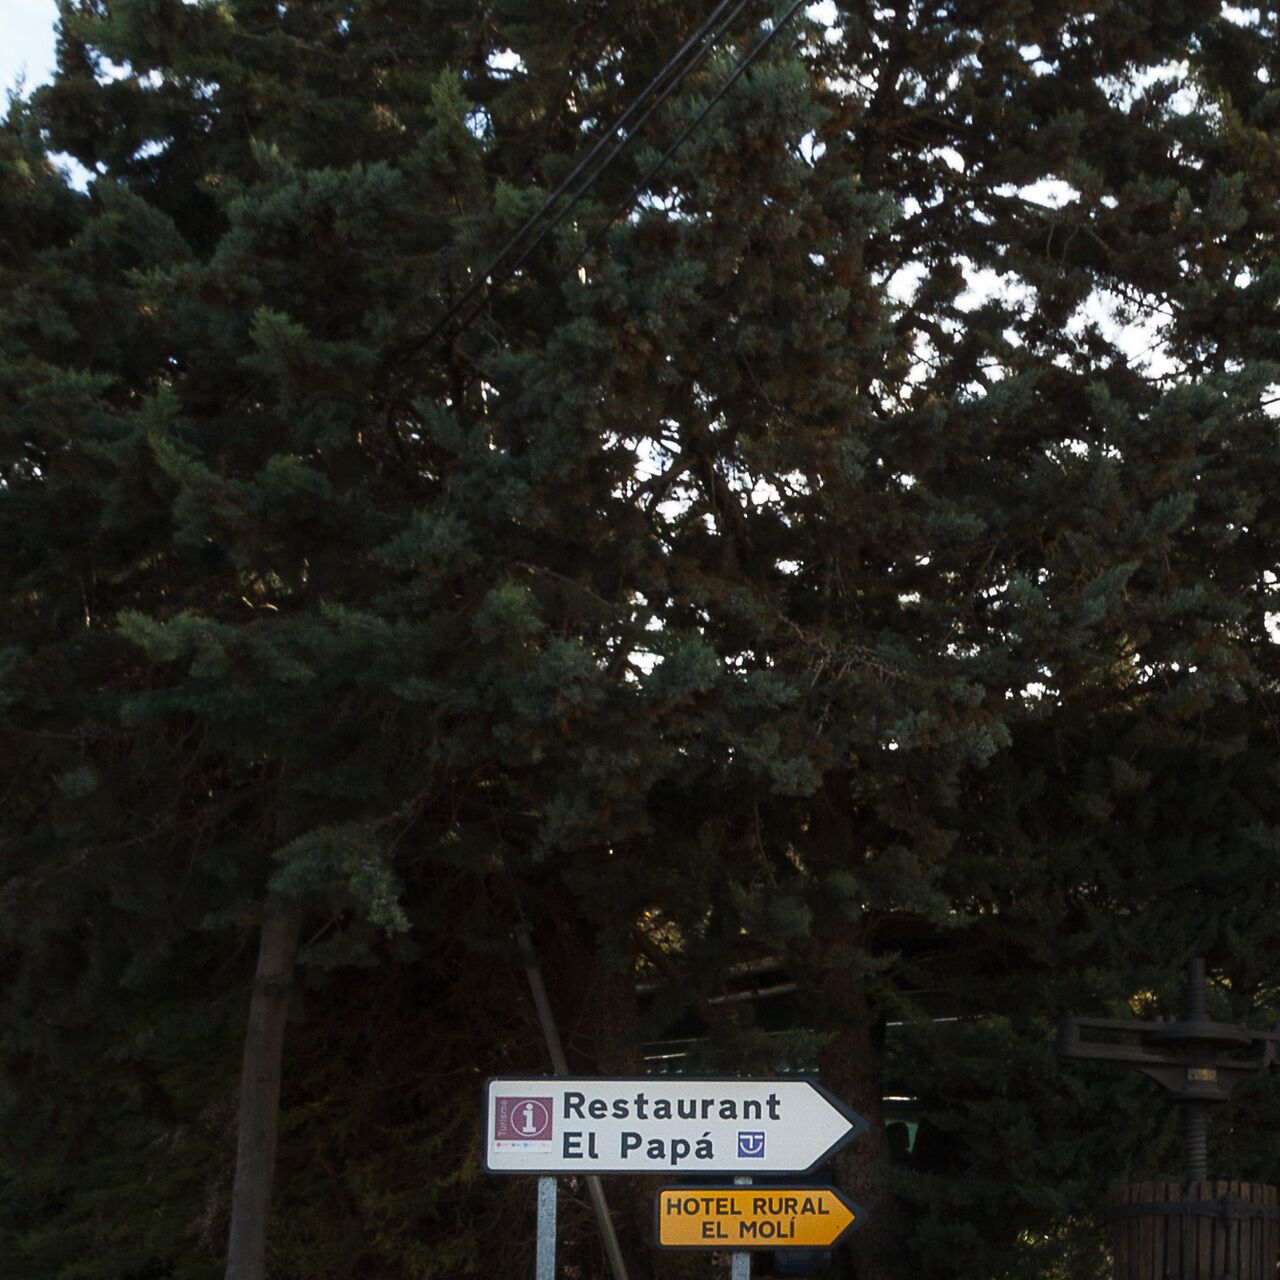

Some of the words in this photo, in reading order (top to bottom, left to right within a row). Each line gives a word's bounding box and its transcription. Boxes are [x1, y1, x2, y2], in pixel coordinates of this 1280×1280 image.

[562, 1092, 781, 1120] Restaurant
[562, 1132, 599, 1159] El
[620, 1132, 715, 1165] Papá
[666, 1197, 742, 1216] HOTEL
[752, 1197, 830, 1216] RURAL
[701, 1221, 729, 1239] EL
[739, 1216, 796, 1239] MOLÍ
